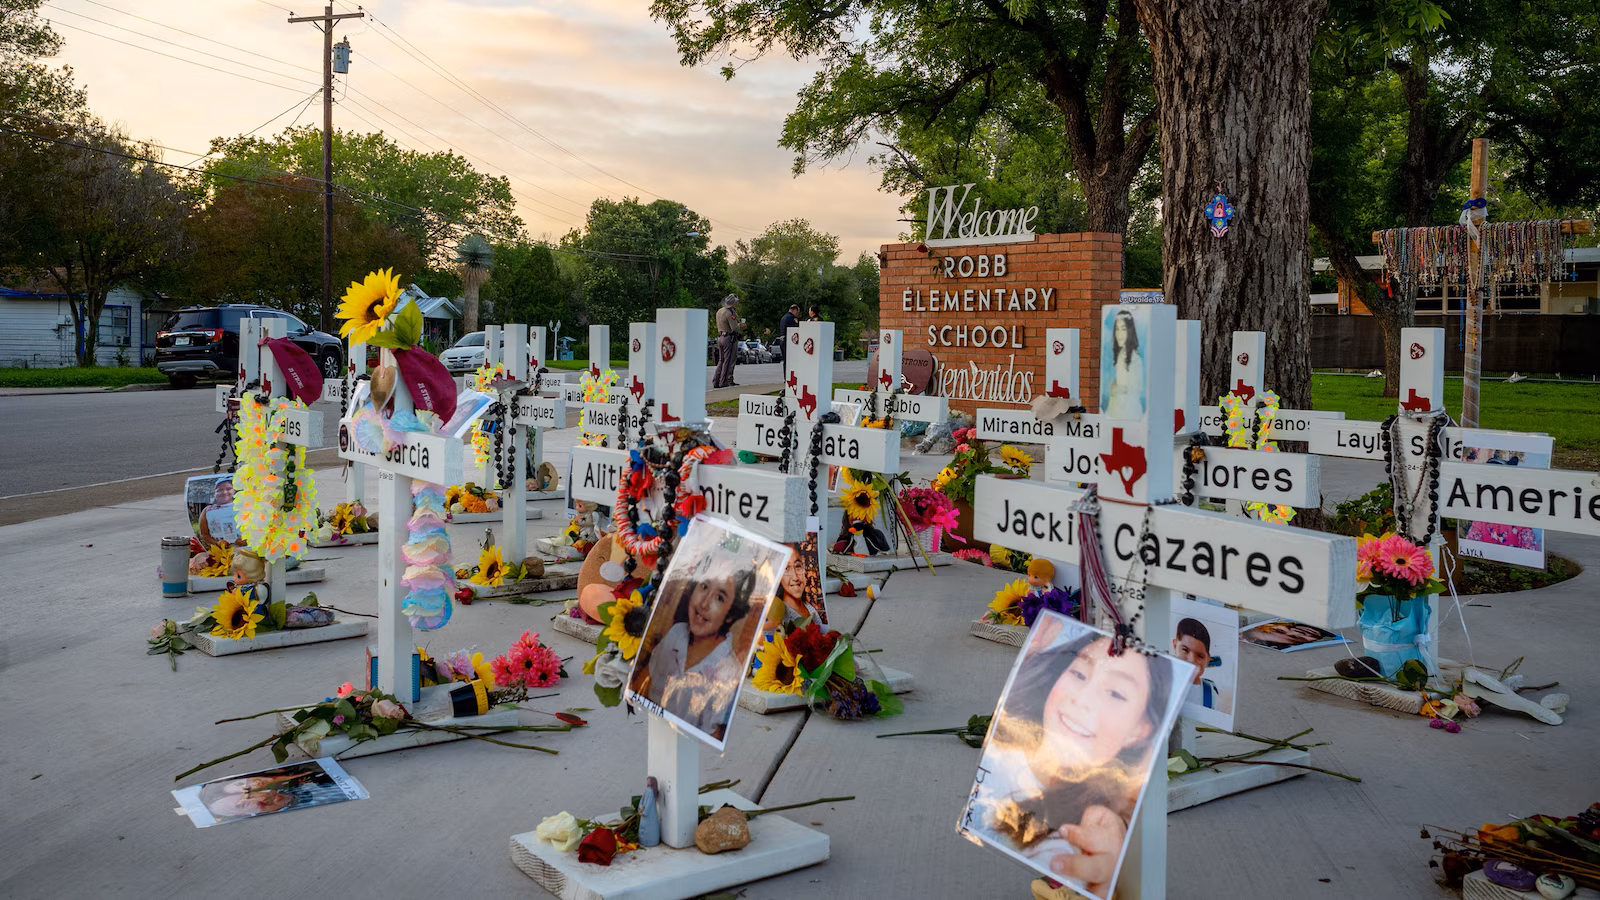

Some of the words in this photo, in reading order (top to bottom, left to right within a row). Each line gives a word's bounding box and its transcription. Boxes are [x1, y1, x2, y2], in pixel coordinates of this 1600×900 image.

[926, 183, 1039, 241] Welcome
[944, 254, 1007, 278] ROBB
[903, 287, 1056, 311] ELEMENTARY
[928, 325, 1024, 348] SCHOOL
[902, 358, 929, 367] STRONG
[884, 398, 920, 414] Rubio
[983, 416, 1054, 436] Miranda
[810, 430, 859, 460] ata
[1337, 430, 1380, 454] Layl
[1203, 459, 1294, 493] lores
[699, 483, 770, 523] mirez
[997, 499, 1074, 545] Jacki
[1114, 523, 1305, 595] Cazares
